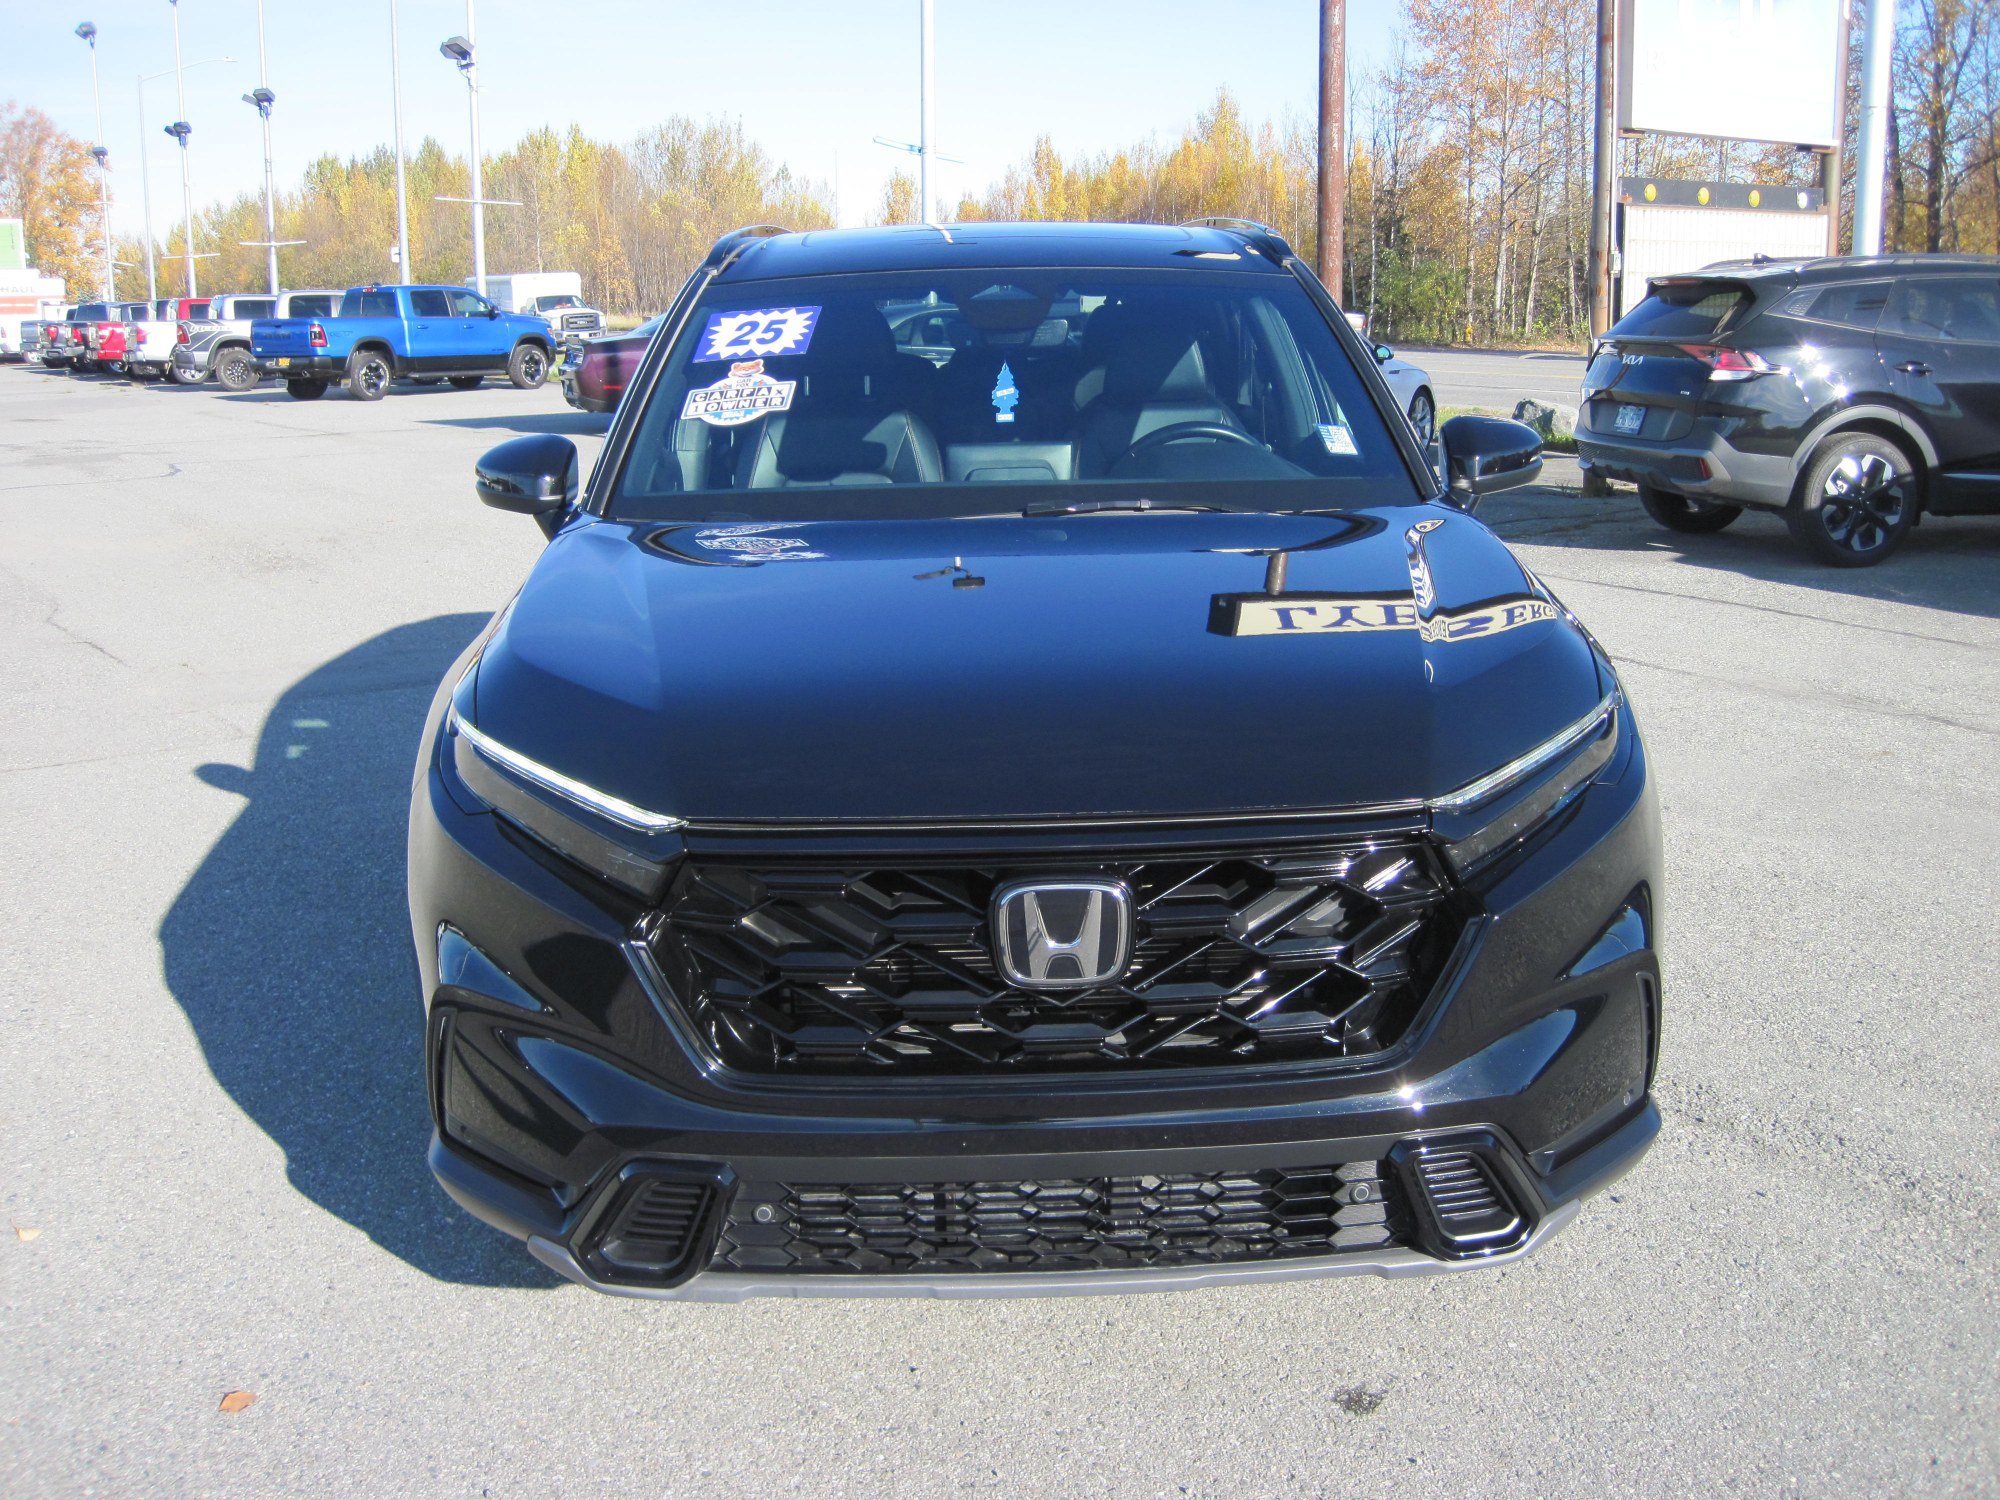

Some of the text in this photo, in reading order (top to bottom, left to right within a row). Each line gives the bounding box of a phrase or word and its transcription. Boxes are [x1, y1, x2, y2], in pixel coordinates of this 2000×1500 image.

[725, 319, 787, 347] 25
[693, 387, 784, 402] CARFAX
[704, 397, 785, 413] OWNER
